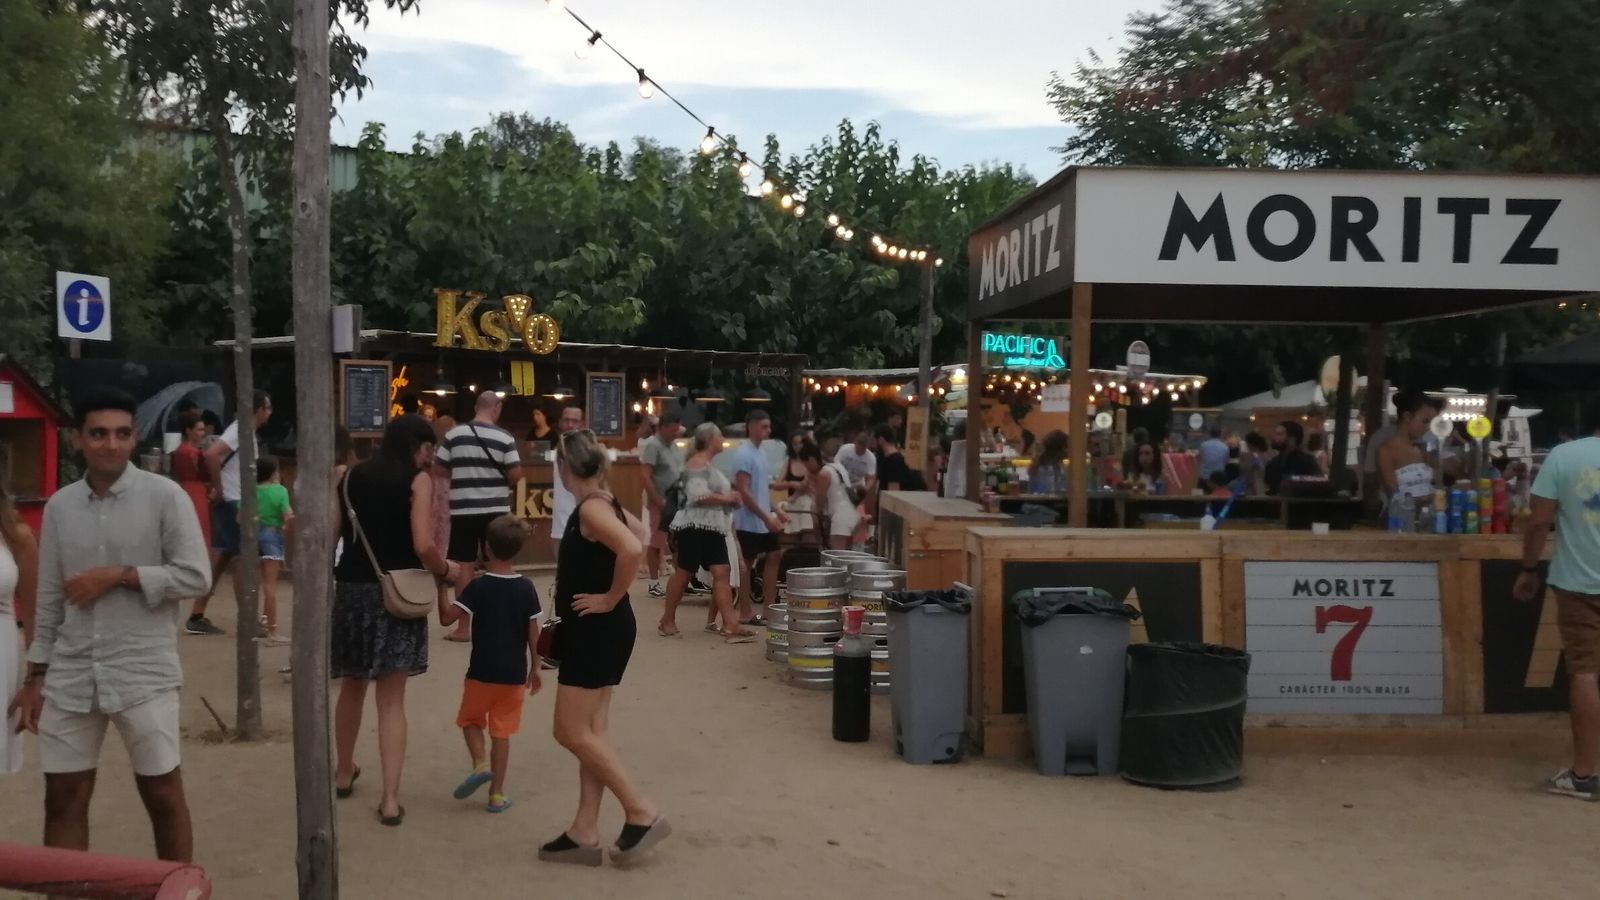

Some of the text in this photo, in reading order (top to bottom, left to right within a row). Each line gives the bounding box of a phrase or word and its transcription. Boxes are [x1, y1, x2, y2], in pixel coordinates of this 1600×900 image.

[979, 203, 1061, 301] MORITZ
[1158, 190, 1562, 265] MORITZ
[984, 333, 1066, 369] PACIFICA
[1293, 578, 1395, 597] MORITZ
[1315, 604, 1373, 681] 7
[1342, 685, 1371, 694] 100%
[1375, 685, 1410, 694] MALTA
